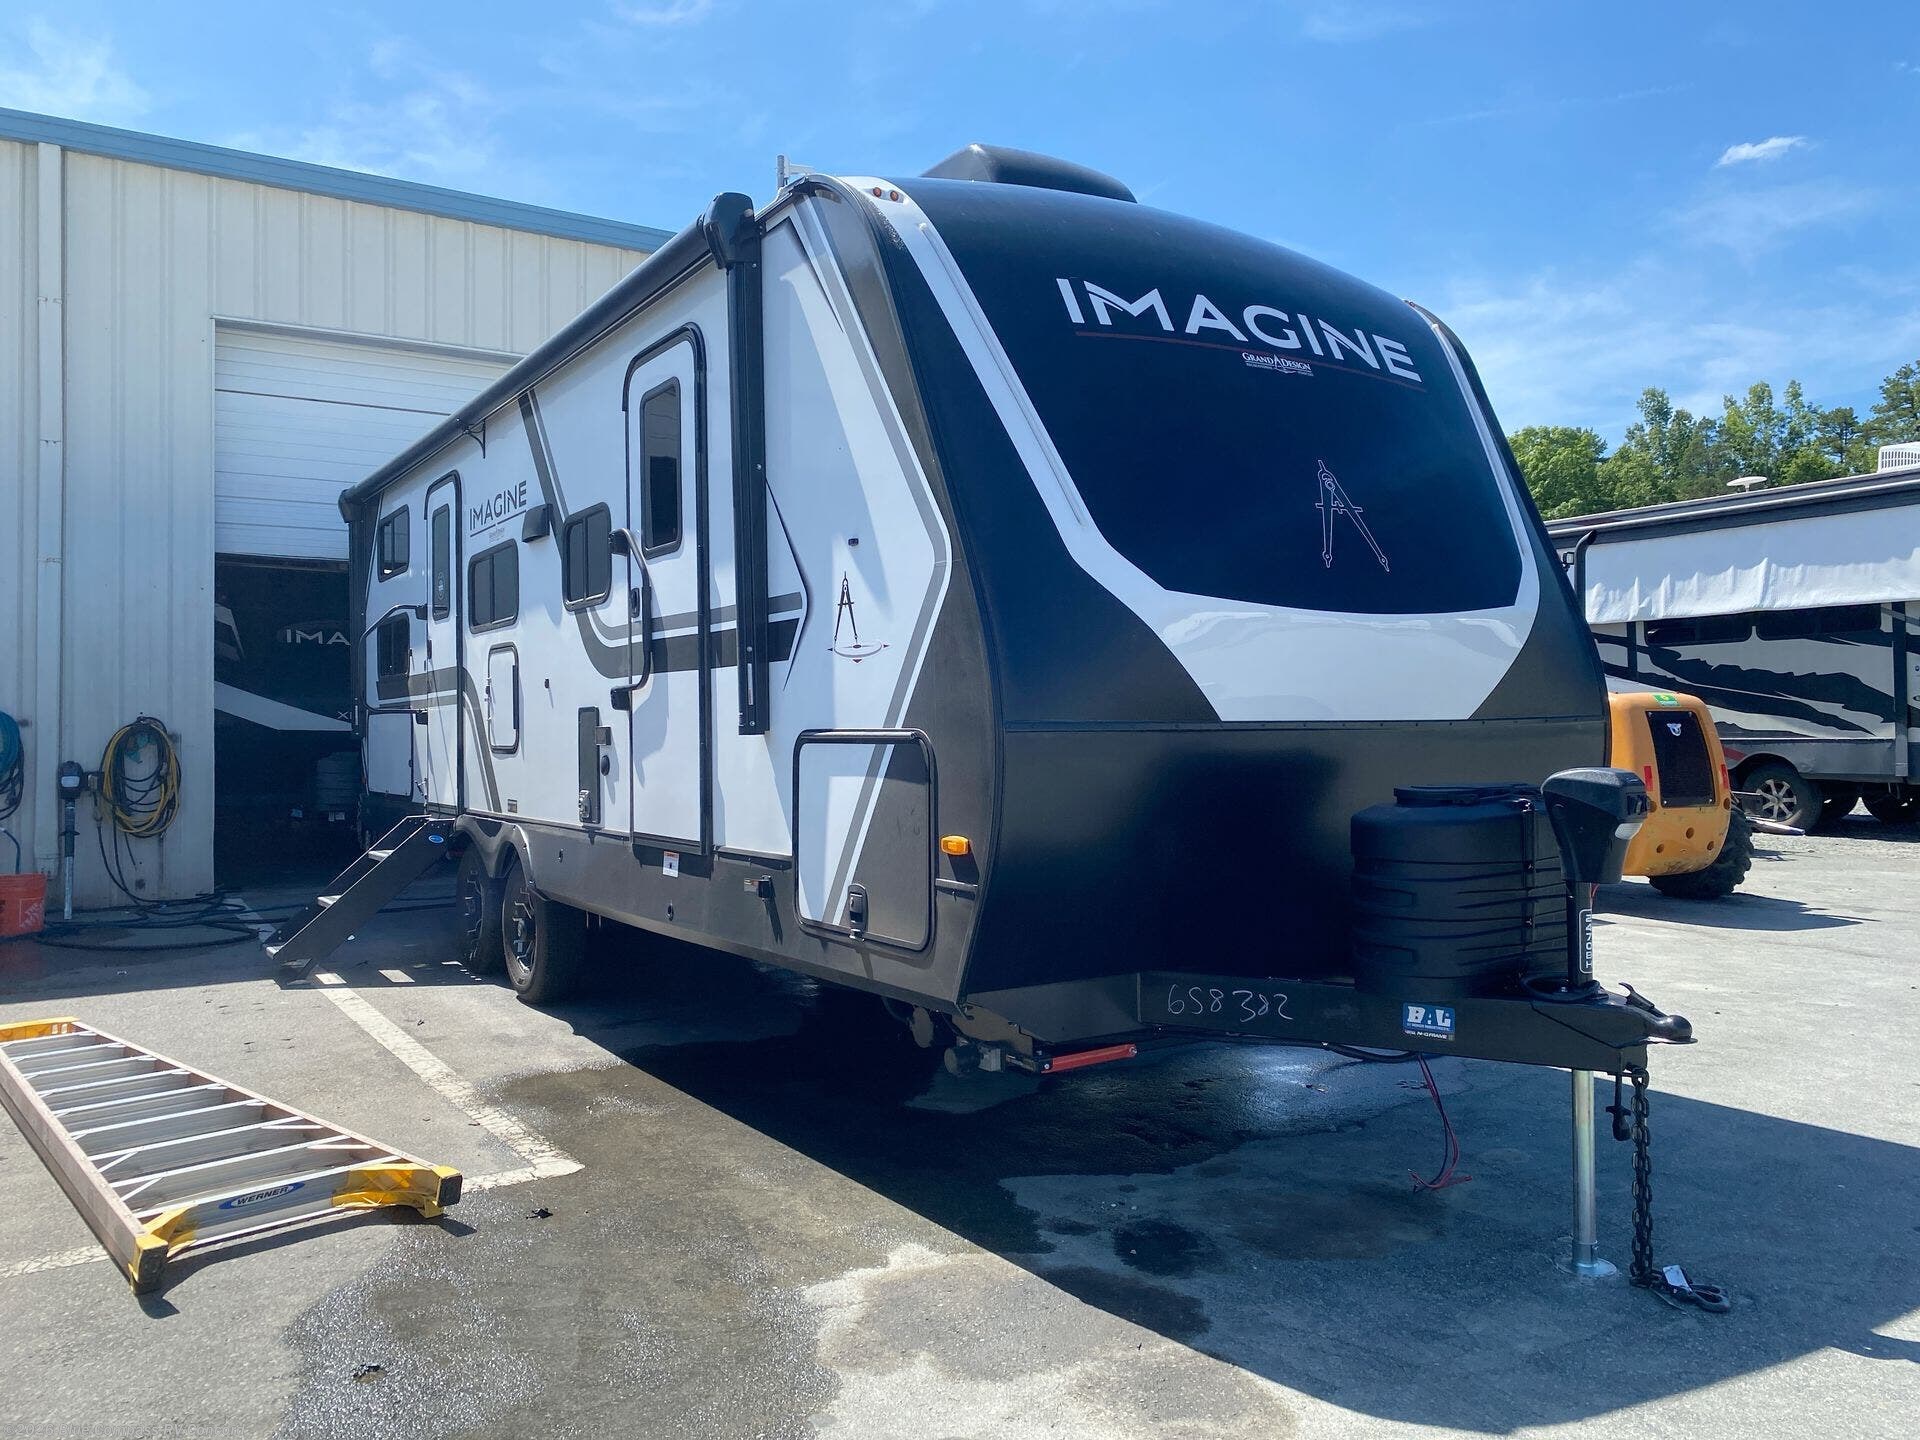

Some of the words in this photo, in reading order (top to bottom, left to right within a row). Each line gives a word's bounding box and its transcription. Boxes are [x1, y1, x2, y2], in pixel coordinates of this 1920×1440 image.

[1056, 277, 1422, 383] IMAGINE
[469, 480, 527, 531] IMAGINE
[1407, 1005, 1452, 1028] BAL
[237, 1185, 290, 1205] WERNER
